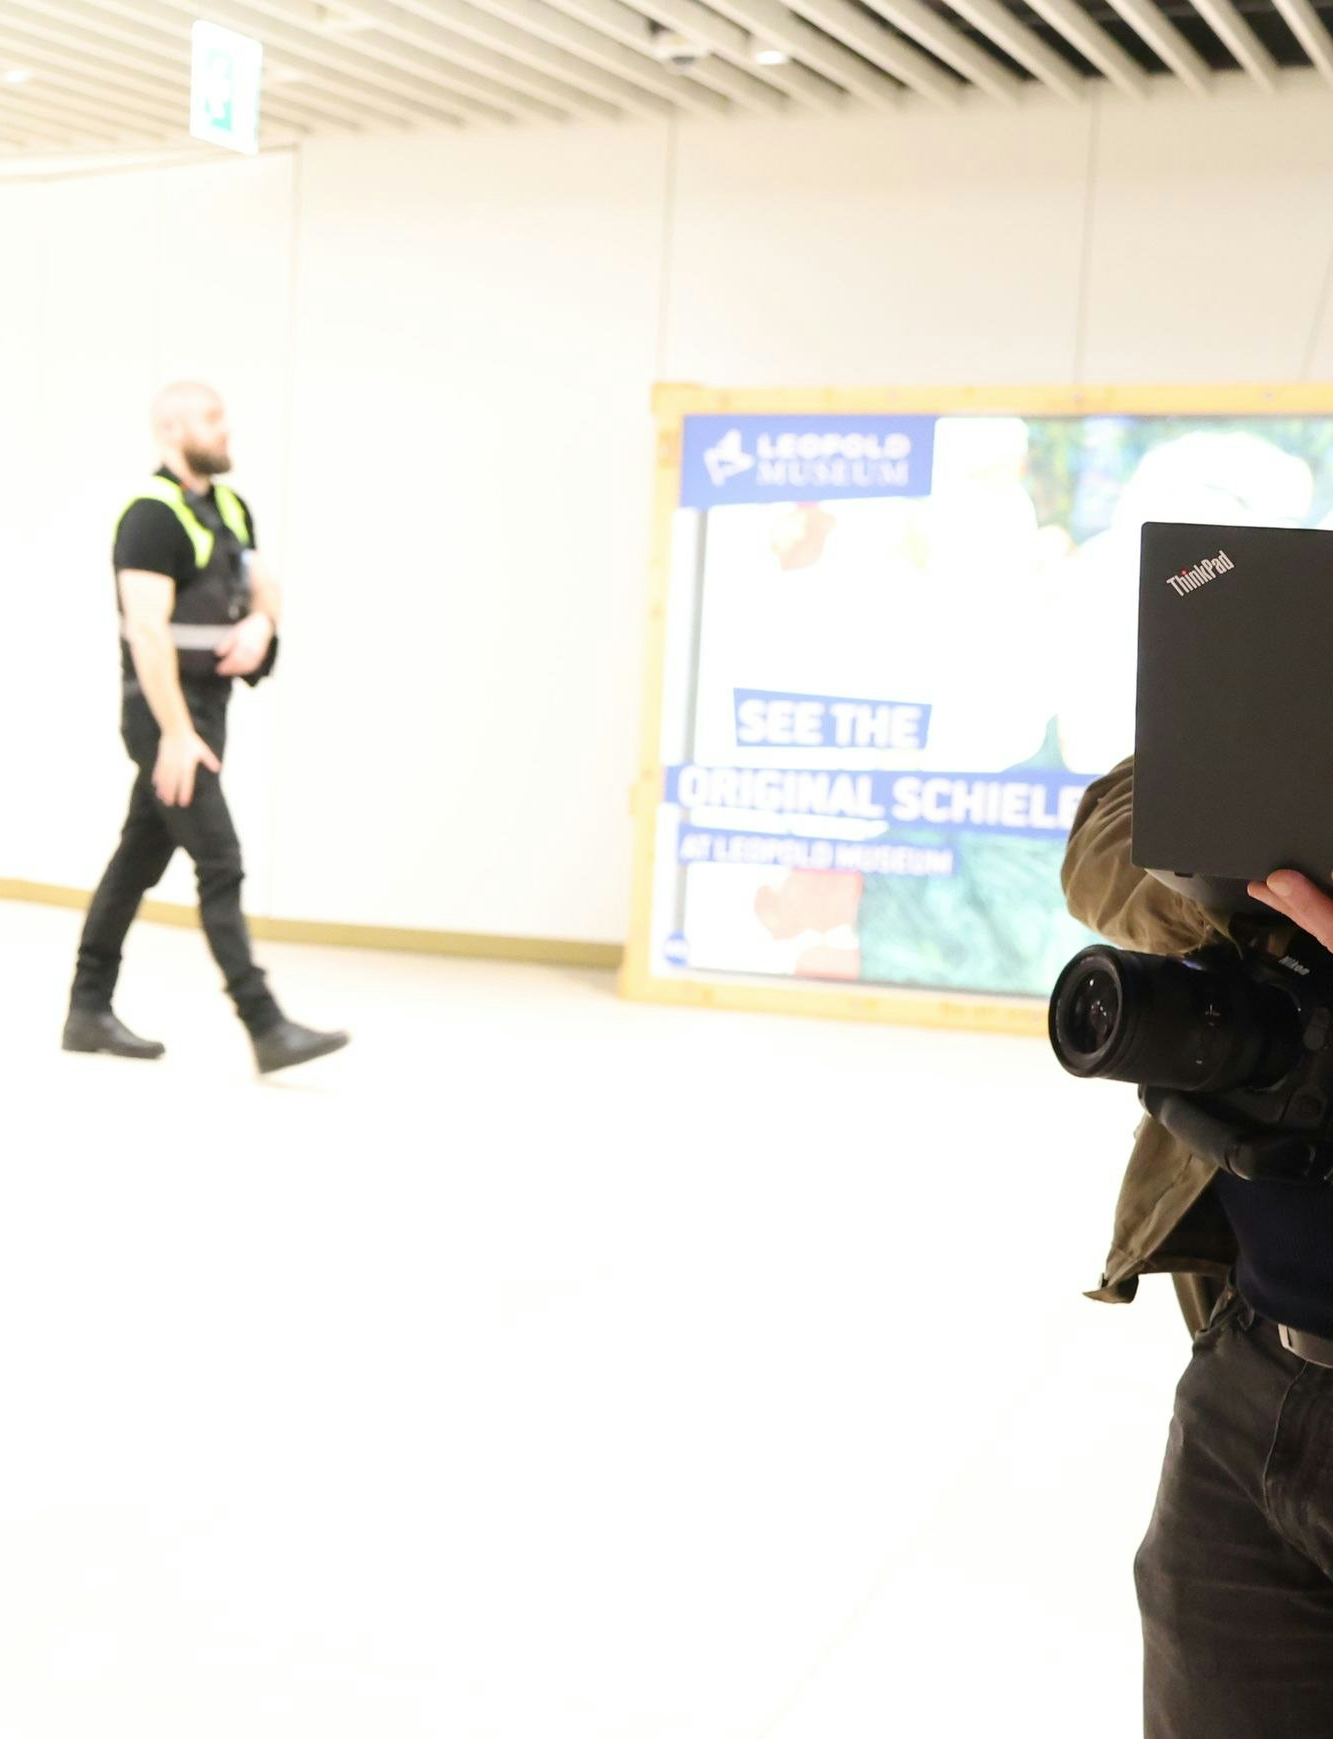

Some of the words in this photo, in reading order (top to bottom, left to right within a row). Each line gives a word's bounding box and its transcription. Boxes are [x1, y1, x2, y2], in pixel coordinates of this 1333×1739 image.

[757, 432, 911, 460] LEOPOLD
[757, 459, 909, 487] MUSEUM
[1166, 550, 1235, 596] ThinkPad
[739, 699, 824, 745] SEE
[832, 705, 922, 748] THE
[679, 766, 885, 817] ORIGINAL
